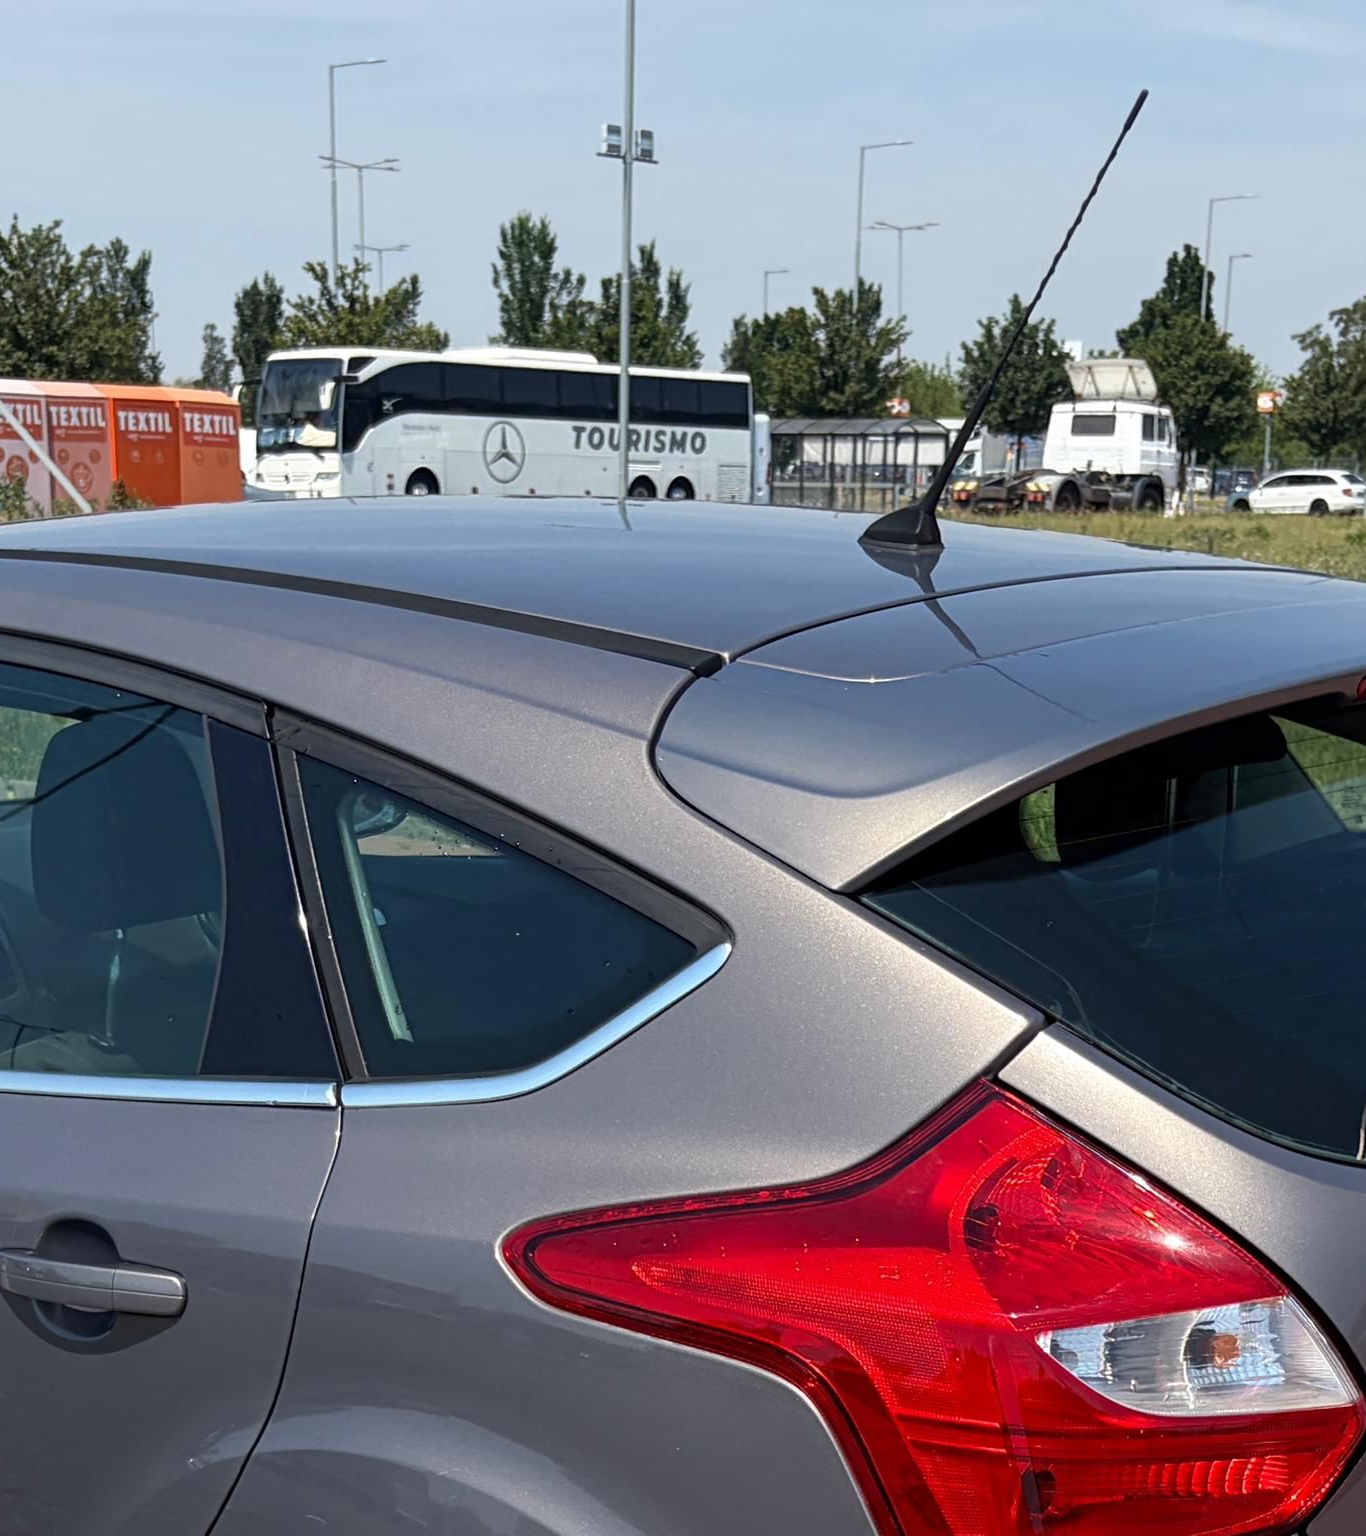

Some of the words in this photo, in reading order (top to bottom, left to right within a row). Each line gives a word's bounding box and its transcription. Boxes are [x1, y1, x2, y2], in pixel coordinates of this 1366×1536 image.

[49, 406, 106, 427] TEXTIL
[118, 410, 173, 433] TEXTIL
[183, 413, 237, 435] TEXTIL
[572, 425, 708, 455] TOURISMO
